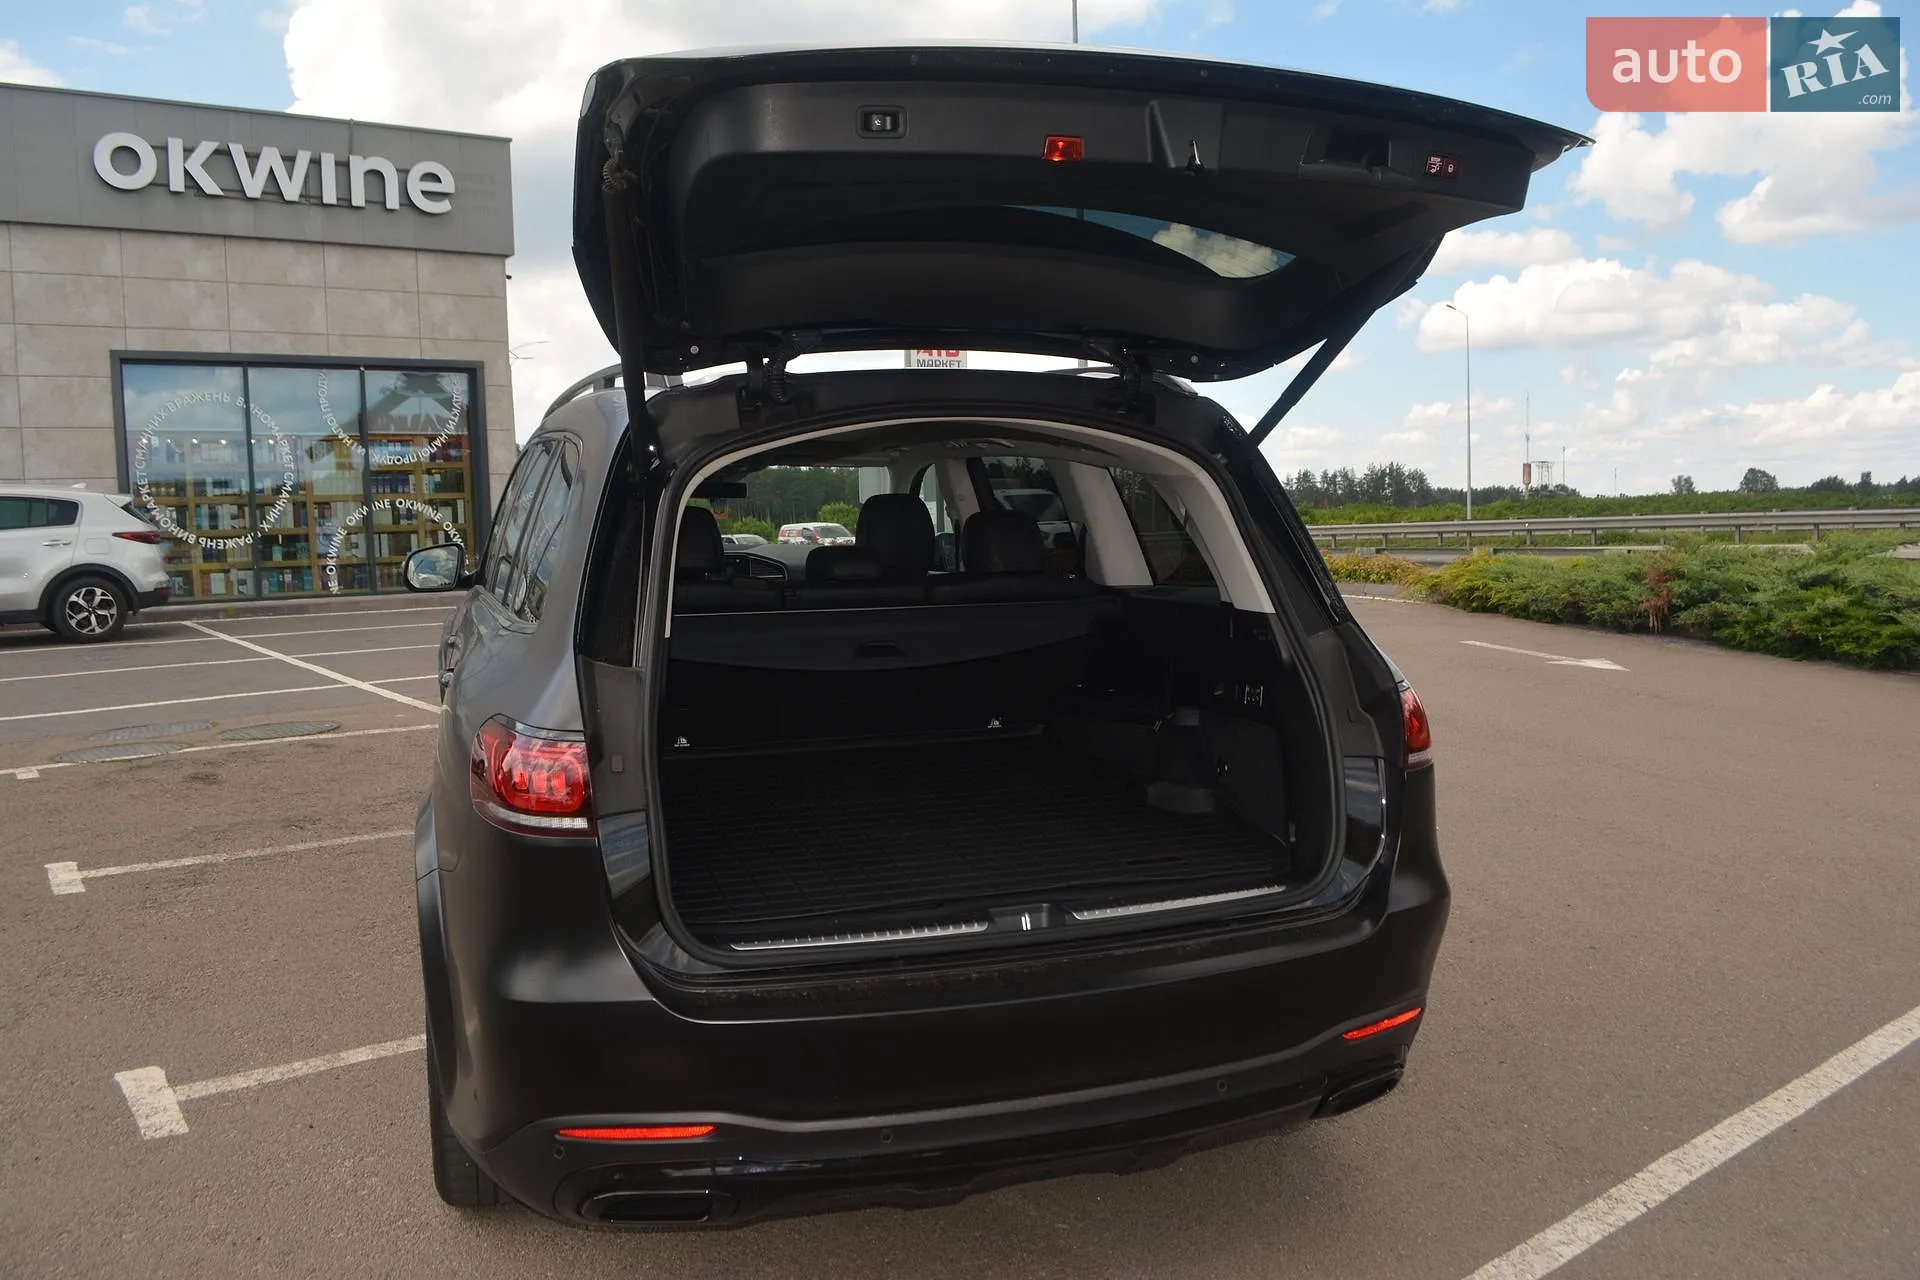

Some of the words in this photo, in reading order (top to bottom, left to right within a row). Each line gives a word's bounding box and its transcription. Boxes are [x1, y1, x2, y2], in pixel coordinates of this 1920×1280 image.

[167, 392, 231, 413] ВРАЖЕНЬ
[447, 378, 462, 431] РОДУКТИ
[419, 432, 449, 458] НАПОЇ
[135, 470, 197, 545] ВИНОМАРКЕТ
[260, 472, 294, 532] СМАЧНИХ
[199, 531, 262, 549] РАЖЕНЬ
[326, 527, 347, 575] OKWINE
[395, 498, 443, 522] OKWINE
